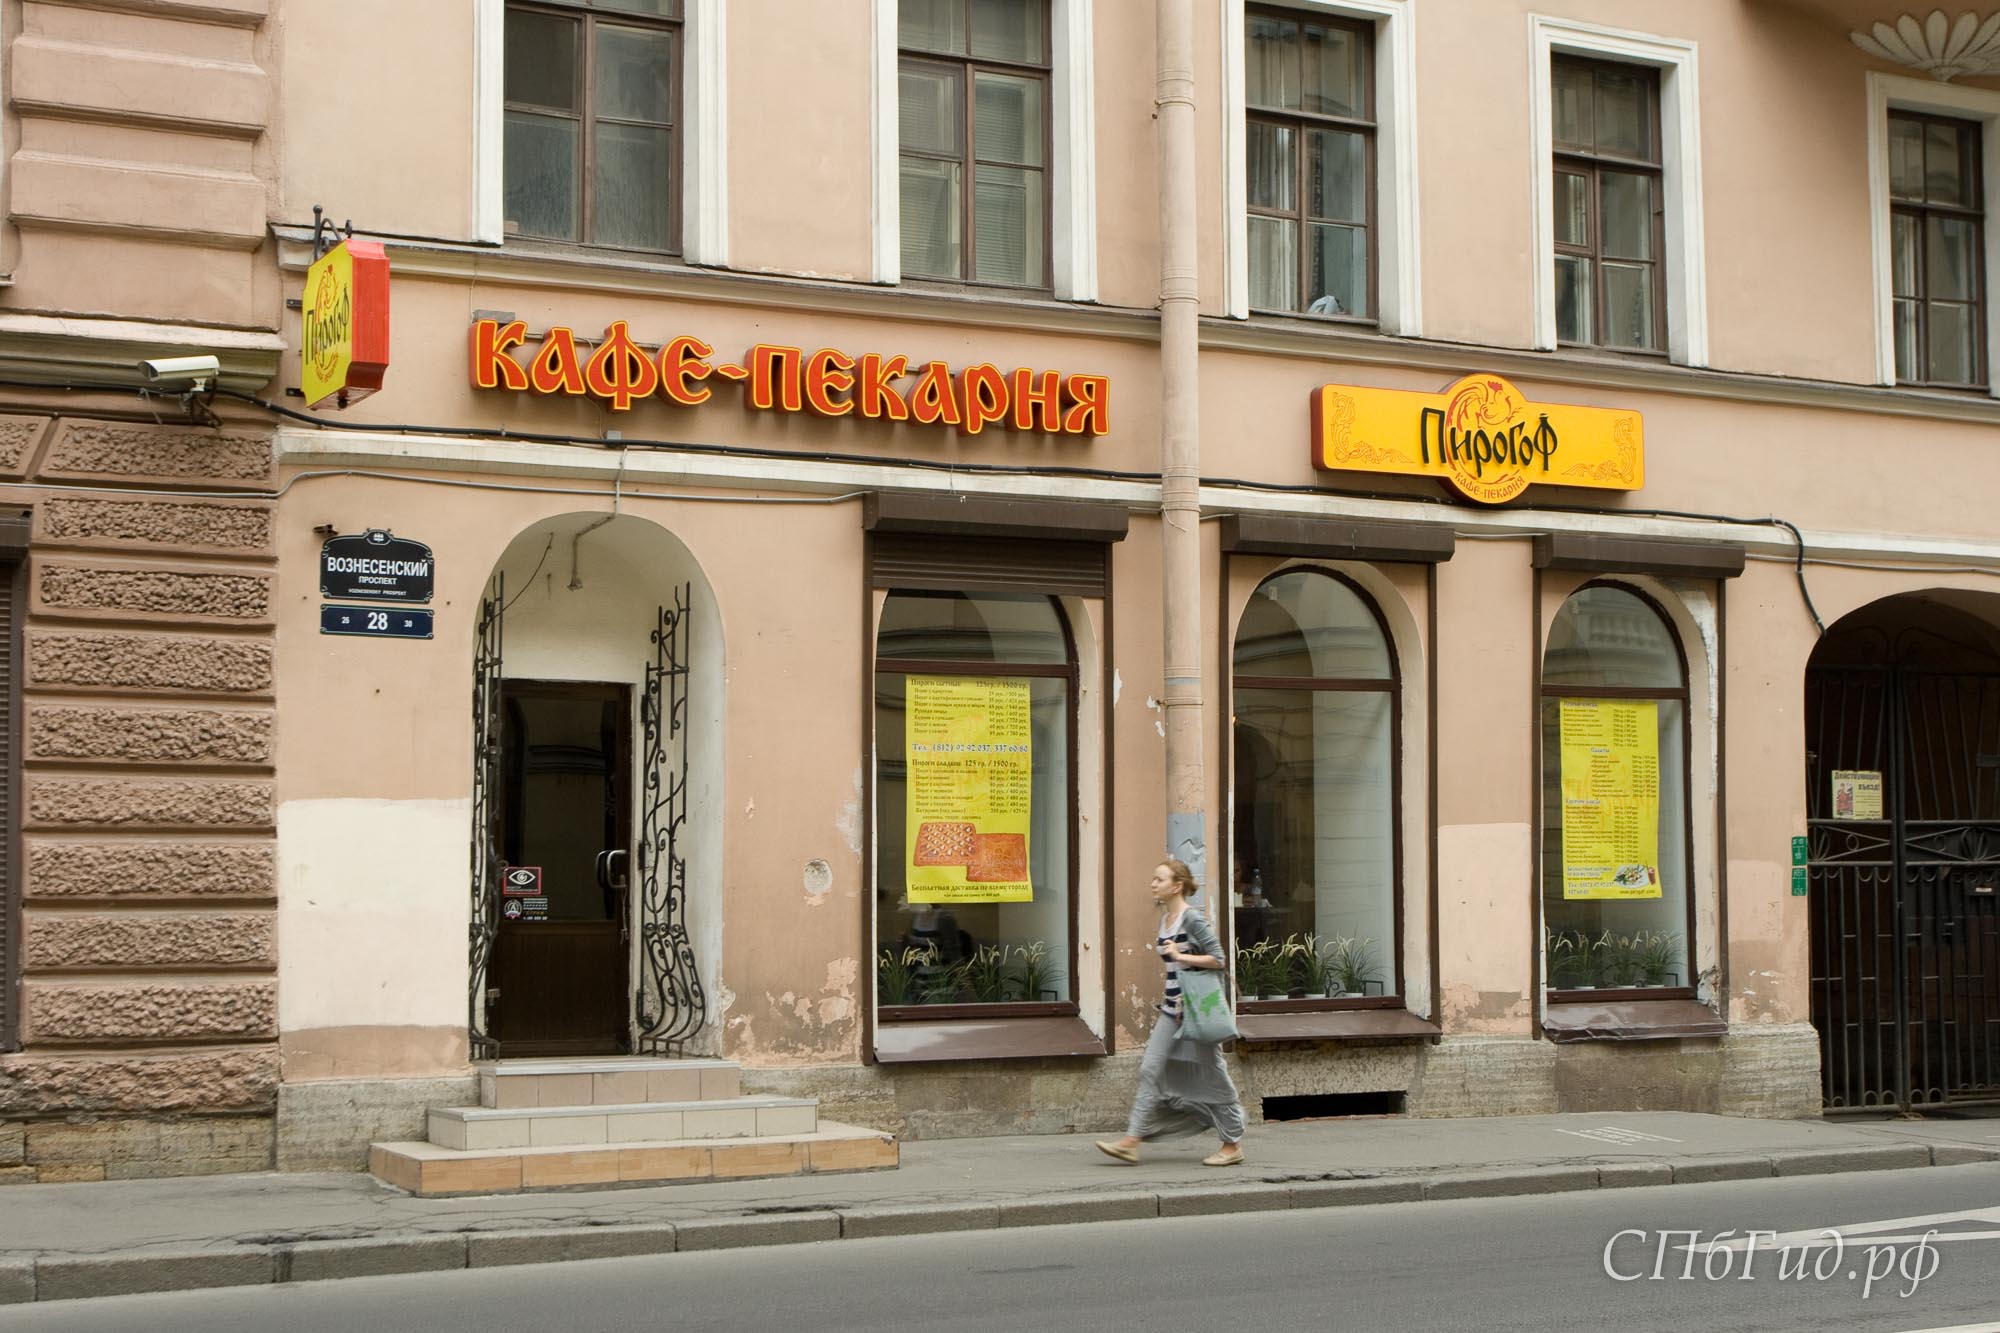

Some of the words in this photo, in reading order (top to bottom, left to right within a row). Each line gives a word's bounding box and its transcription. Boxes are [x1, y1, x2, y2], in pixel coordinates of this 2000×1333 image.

[327, 556, 428, 577] ВОЗНЕСЕНСКИЙ
[358, 576, 398, 585] ПРОСПЕКТ
[367, 612, 388, 630] 28
[933, 743, 954, 752] (812)
